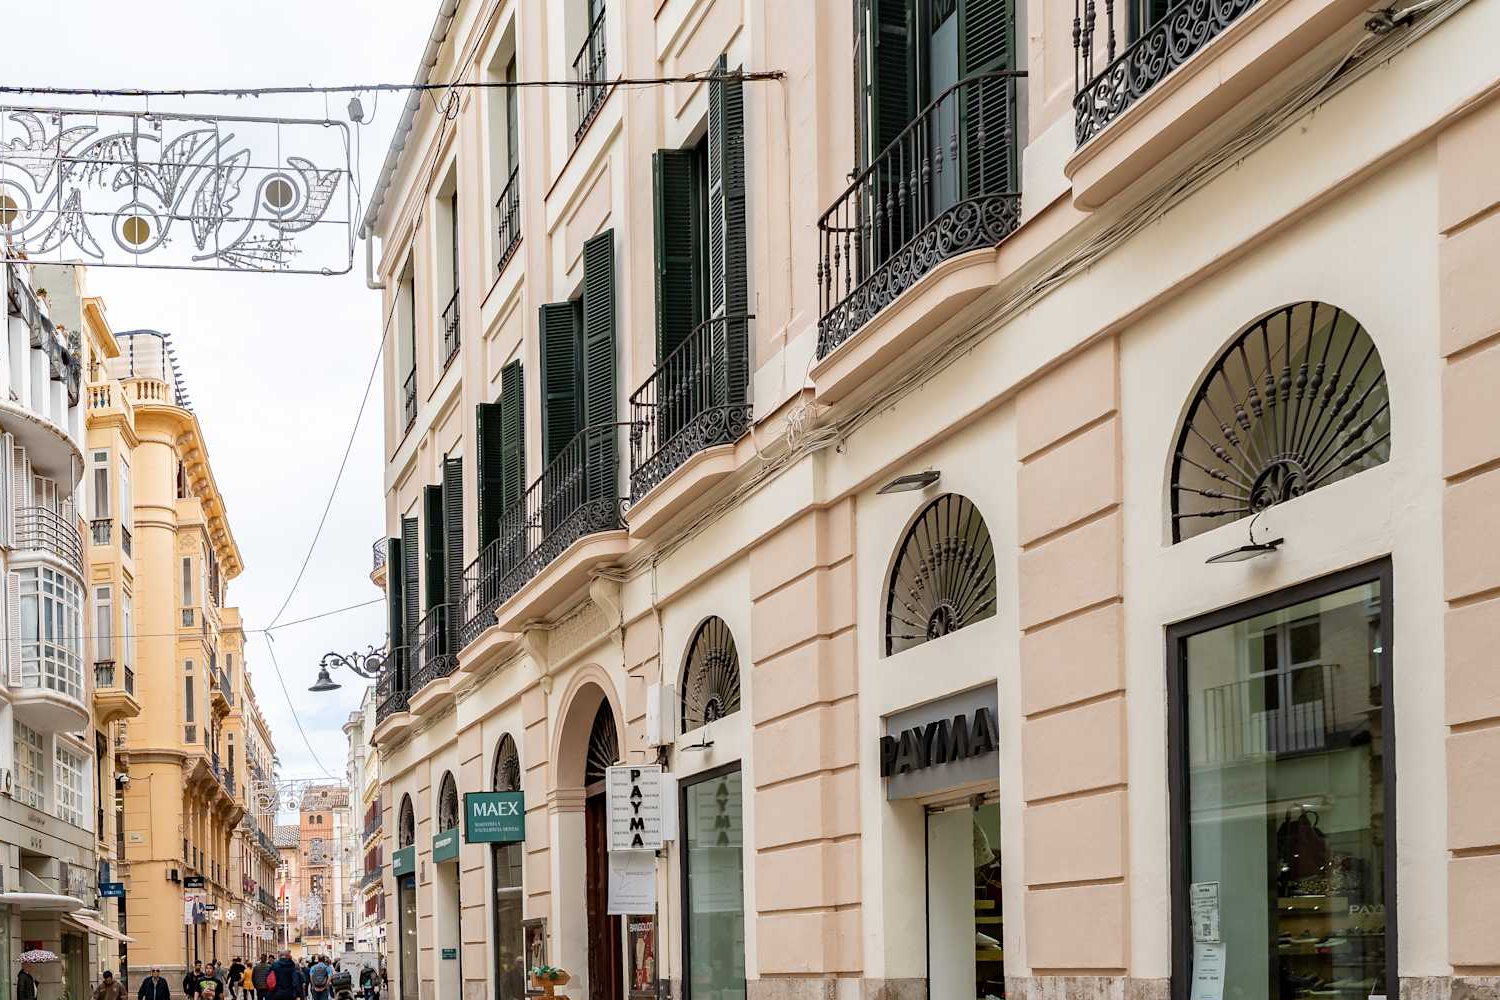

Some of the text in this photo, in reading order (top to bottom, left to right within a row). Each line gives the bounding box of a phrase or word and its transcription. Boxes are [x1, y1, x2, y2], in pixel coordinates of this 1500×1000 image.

[879, 707, 997, 778] PAYMA
[473, 801, 519, 817] MAEX
[629, 769, 645, 849] PAYMA
